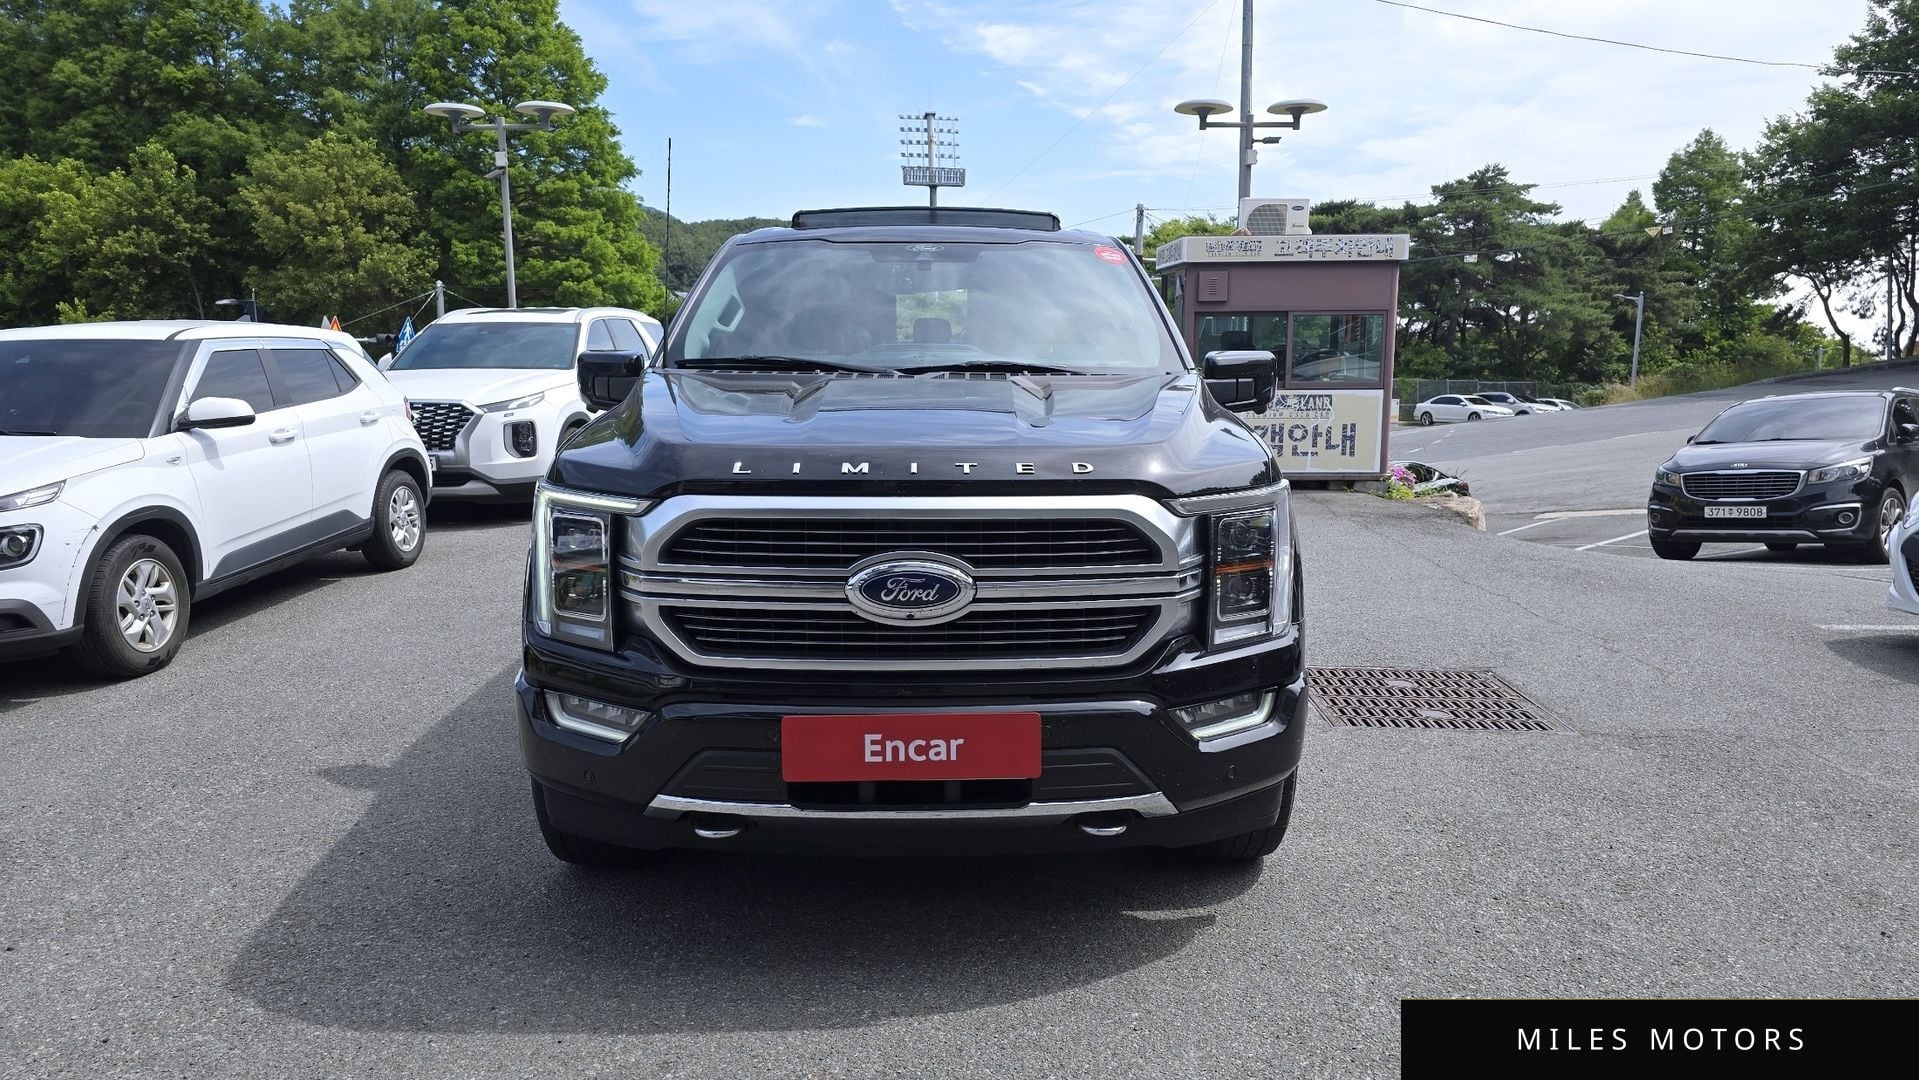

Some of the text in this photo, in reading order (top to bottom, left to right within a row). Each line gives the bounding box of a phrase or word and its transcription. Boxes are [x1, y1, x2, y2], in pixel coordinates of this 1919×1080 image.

[731, 461, 1094, 475] LIMITED
[1736, 507, 1763, 517] 9808
[880, 577, 940, 602] Ford
[864, 733, 965, 763] Encar
